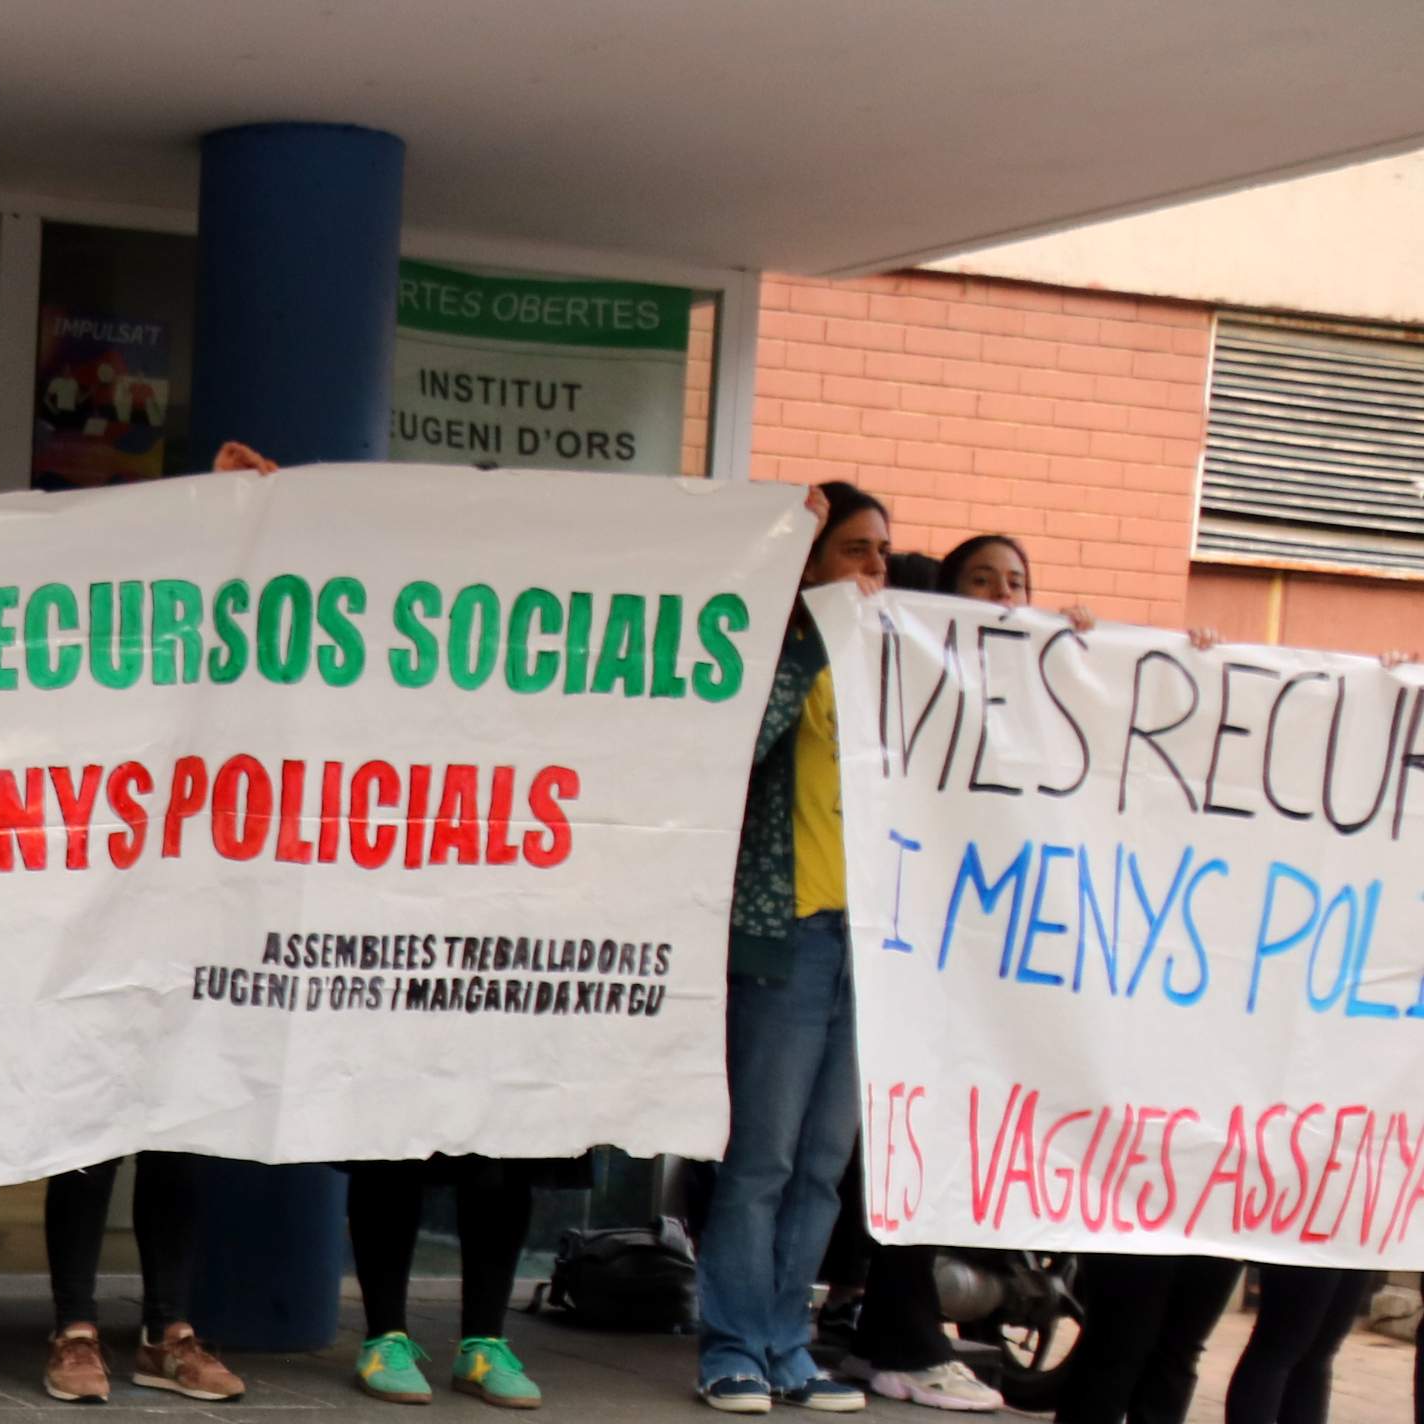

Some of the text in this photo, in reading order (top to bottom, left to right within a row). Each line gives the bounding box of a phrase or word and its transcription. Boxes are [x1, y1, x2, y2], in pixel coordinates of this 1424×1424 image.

[54, 317, 162, 345] IMPULSA'T
[492, 293, 661, 331] OBERTES
[419, 368, 583, 412] INSTITUT
[518, 427, 636, 461] D'ORS
[389, 580, 750, 703] SOCIALS
[878, 608, 1090, 797] MÉS
[161, 752, 580, 870] POLICIALS
[882, 828, 923, 954] I
[937, 840, 1229, 1008] MENYS
[262, 931, 672, 977] ASSEMBLEES TREBALLADORES
[192, 965, 298, 1012] EUGENI
[305, 974, 386, 1013] D'ORS
[390, 976, 402, 1012] I
[406, 976, 570, 1015] MARGARIDA
[868, 1082, 925, 1232] LES
[968, 1082, 1202, 1233] VAGUES
